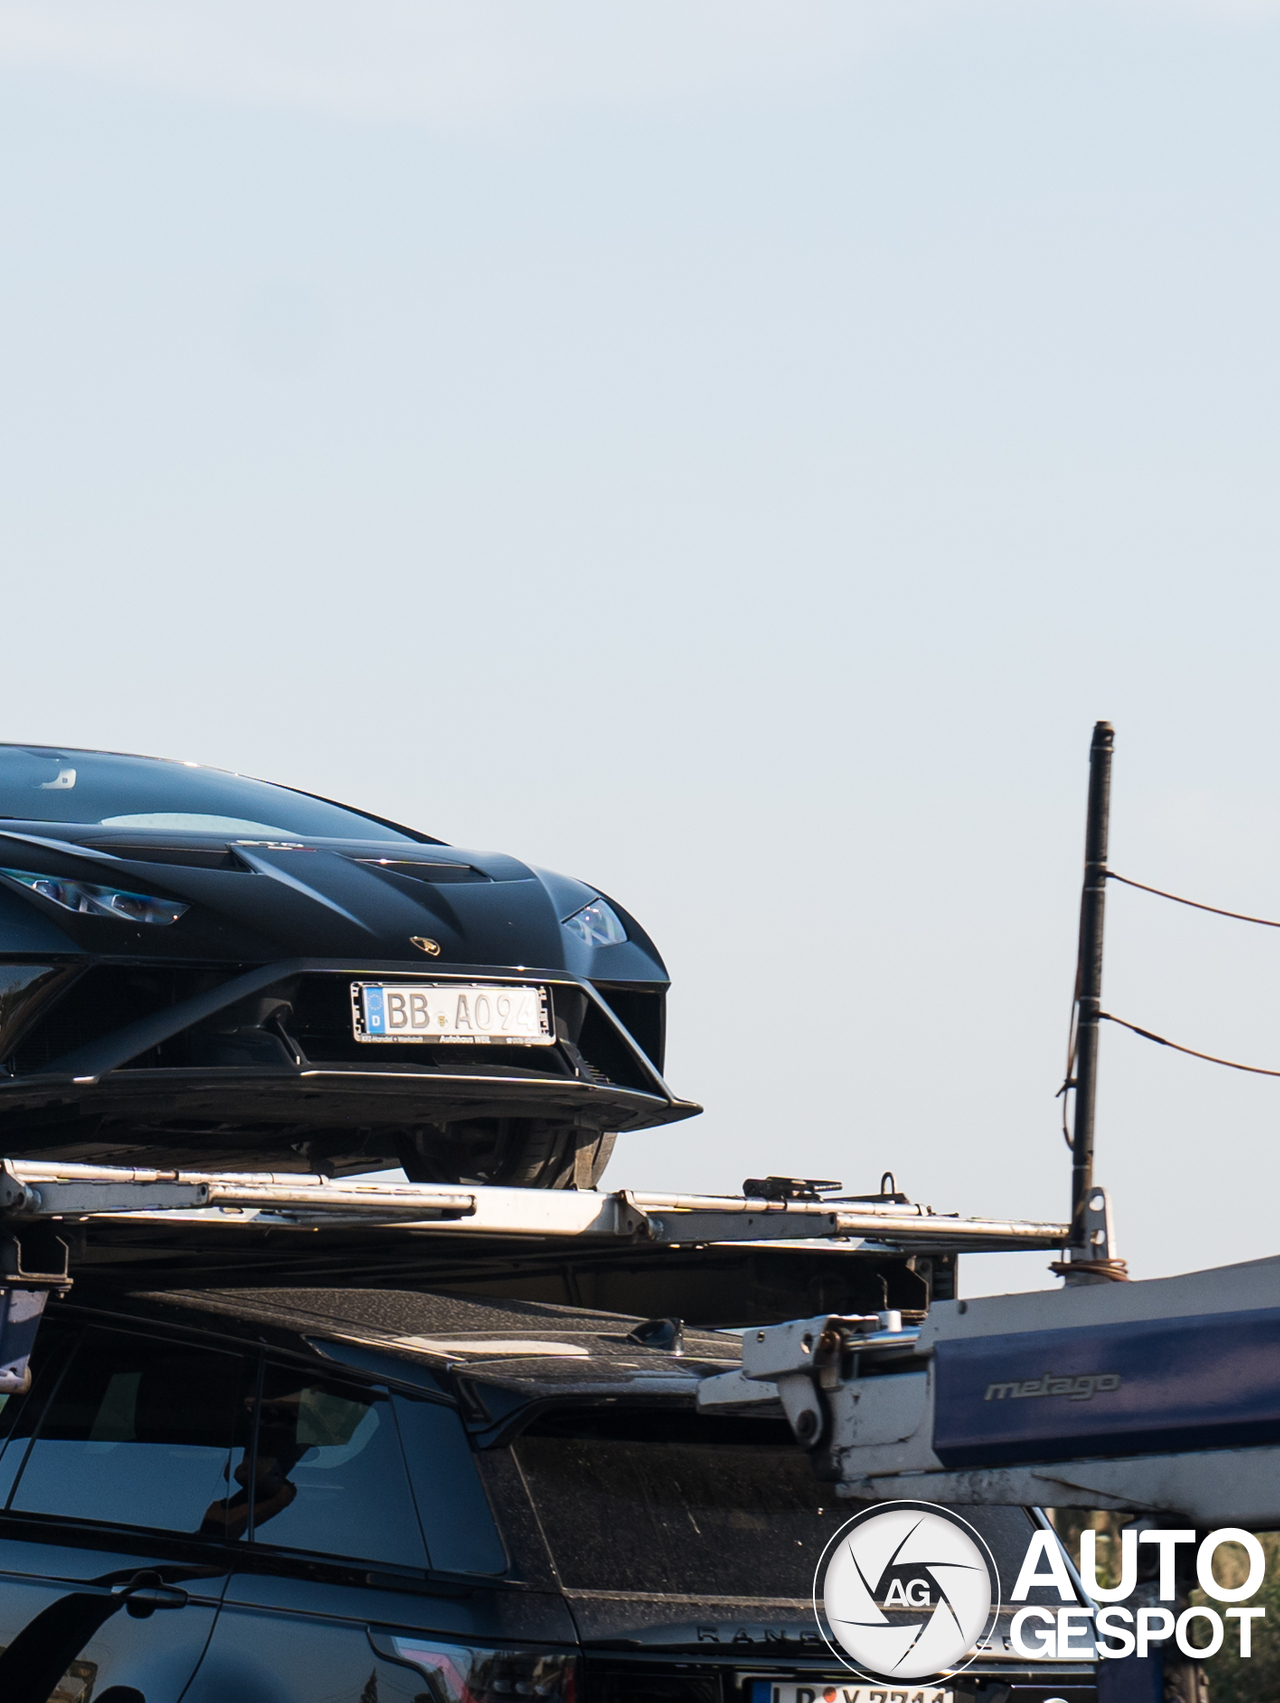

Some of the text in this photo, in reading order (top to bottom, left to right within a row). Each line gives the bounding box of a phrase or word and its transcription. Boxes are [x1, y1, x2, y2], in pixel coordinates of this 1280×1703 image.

[371, 1015, 381, 1027] D
[387, 993, 430, 1029] BB
[983, 1373, 1120, 1401] metago
[696, 1625, 839, 1646] RANG
